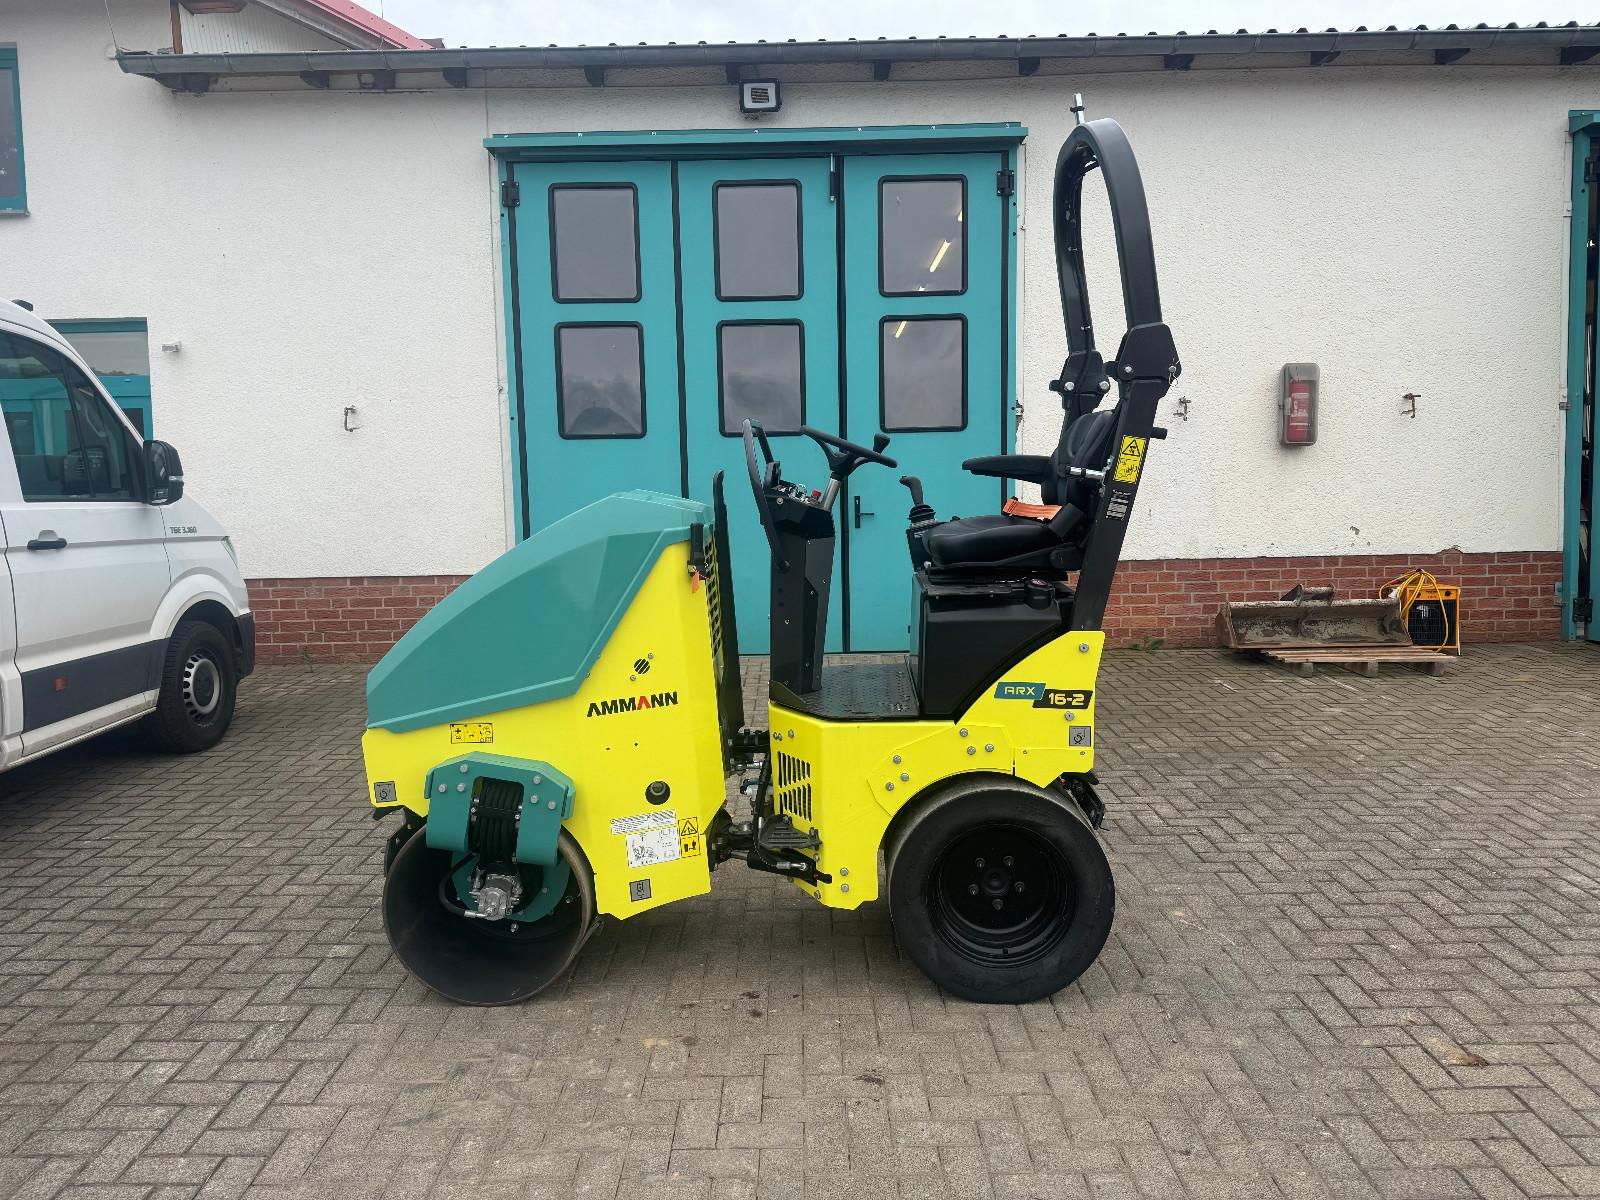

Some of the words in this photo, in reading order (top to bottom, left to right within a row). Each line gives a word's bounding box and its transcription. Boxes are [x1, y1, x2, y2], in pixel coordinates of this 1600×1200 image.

[587, 691, 678, 717] AMMANN
[1004, 686, 1035, 695] ARX
[1048, 692, 1085, 706] 16-2
